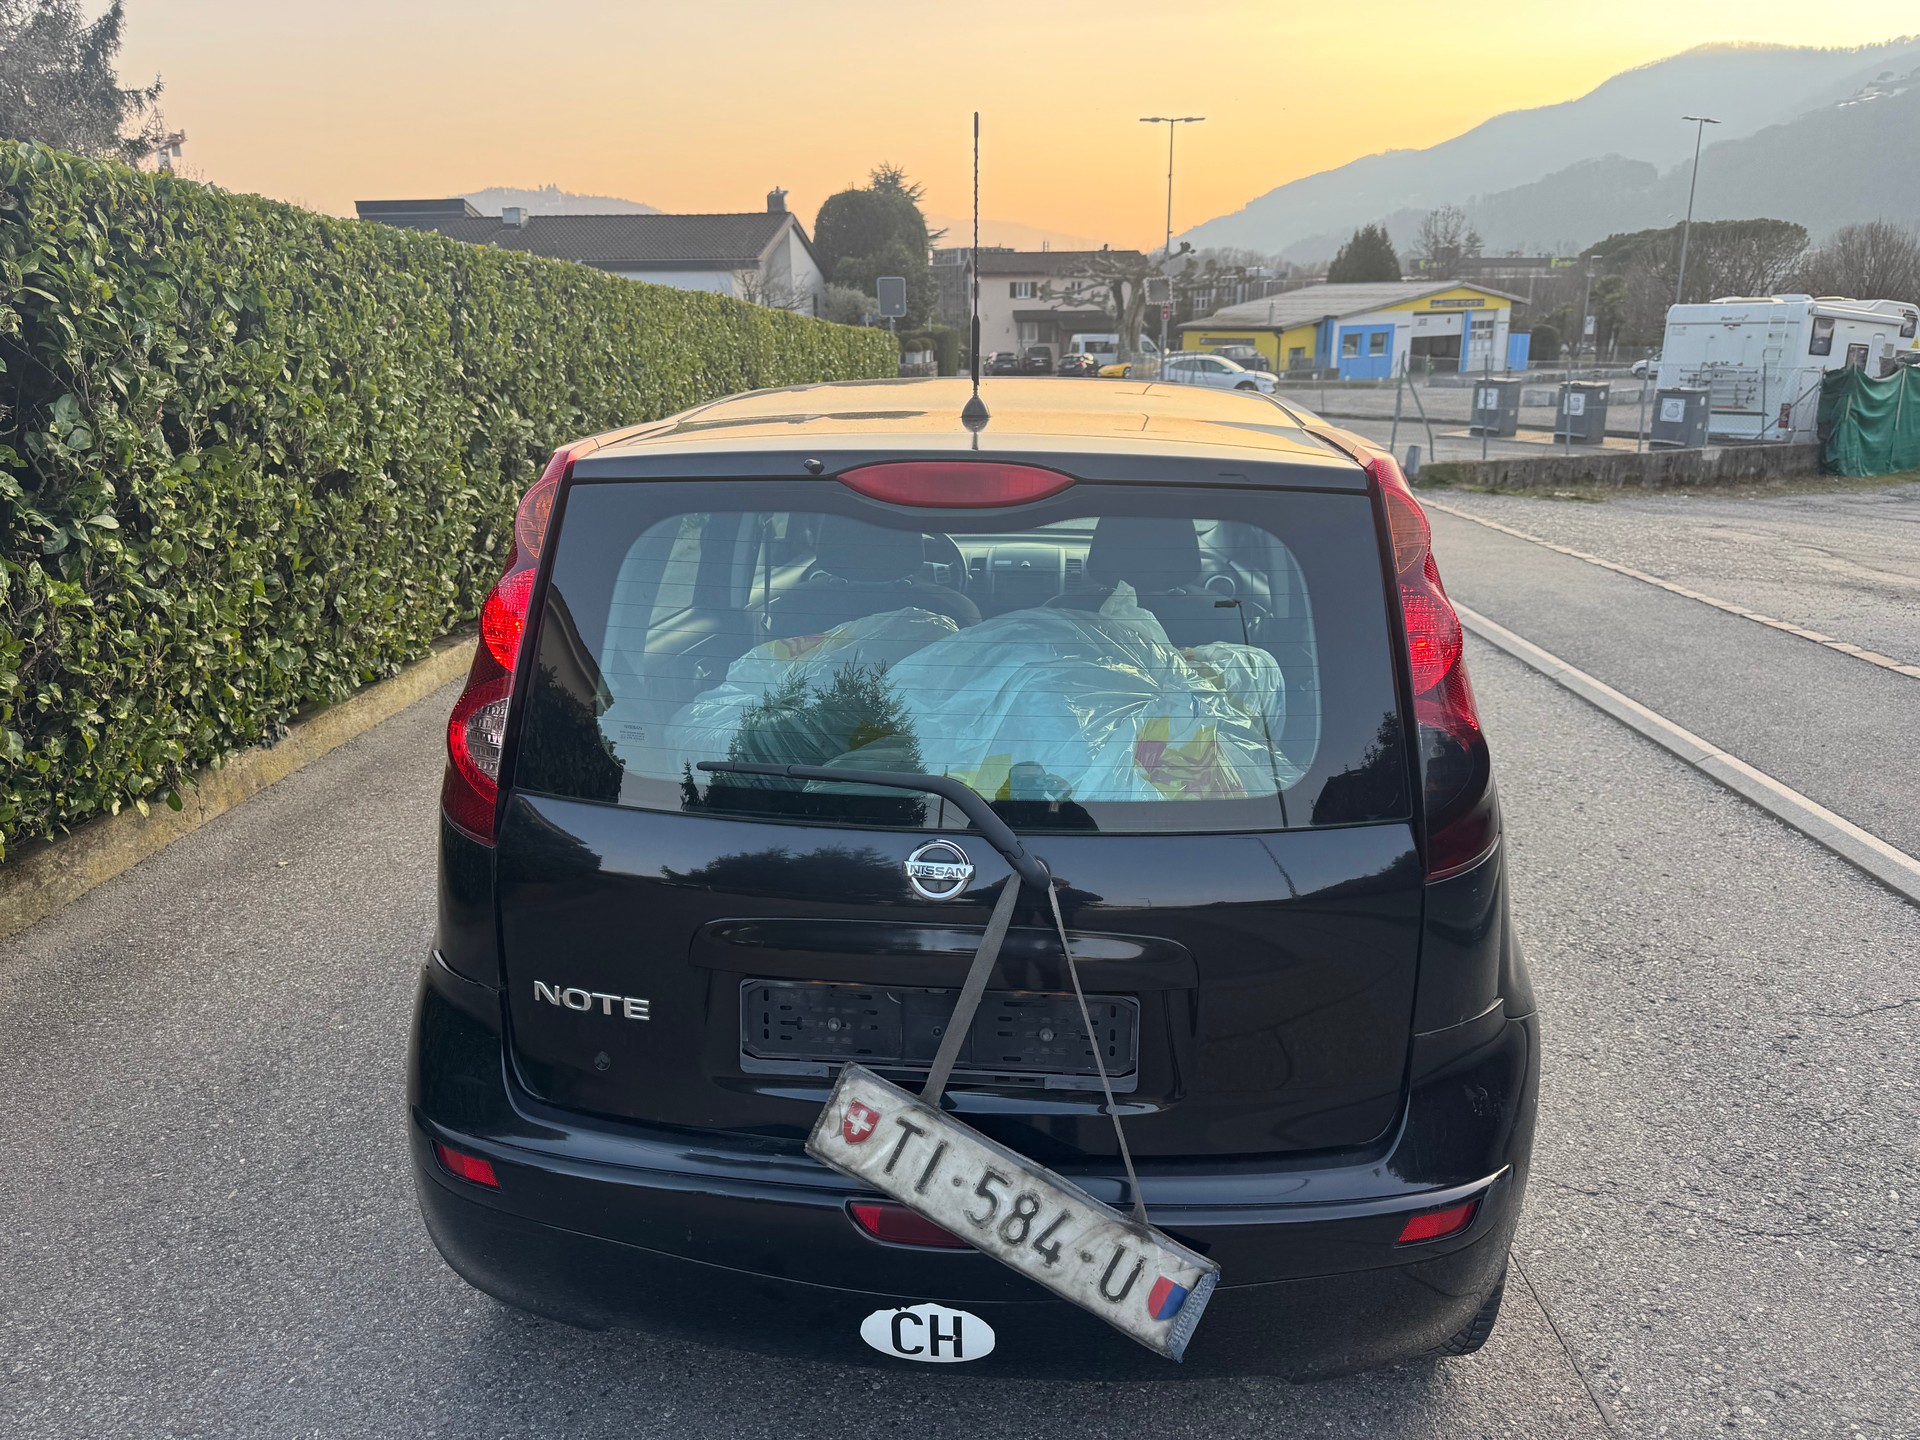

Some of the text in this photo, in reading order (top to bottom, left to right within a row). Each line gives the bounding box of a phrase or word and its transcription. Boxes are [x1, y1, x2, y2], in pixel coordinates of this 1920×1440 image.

[910, 864, 966, 877] NISSAN
[534, 980, 650, 1020] NOTE
[890, 1311, 963, 1359] CH
